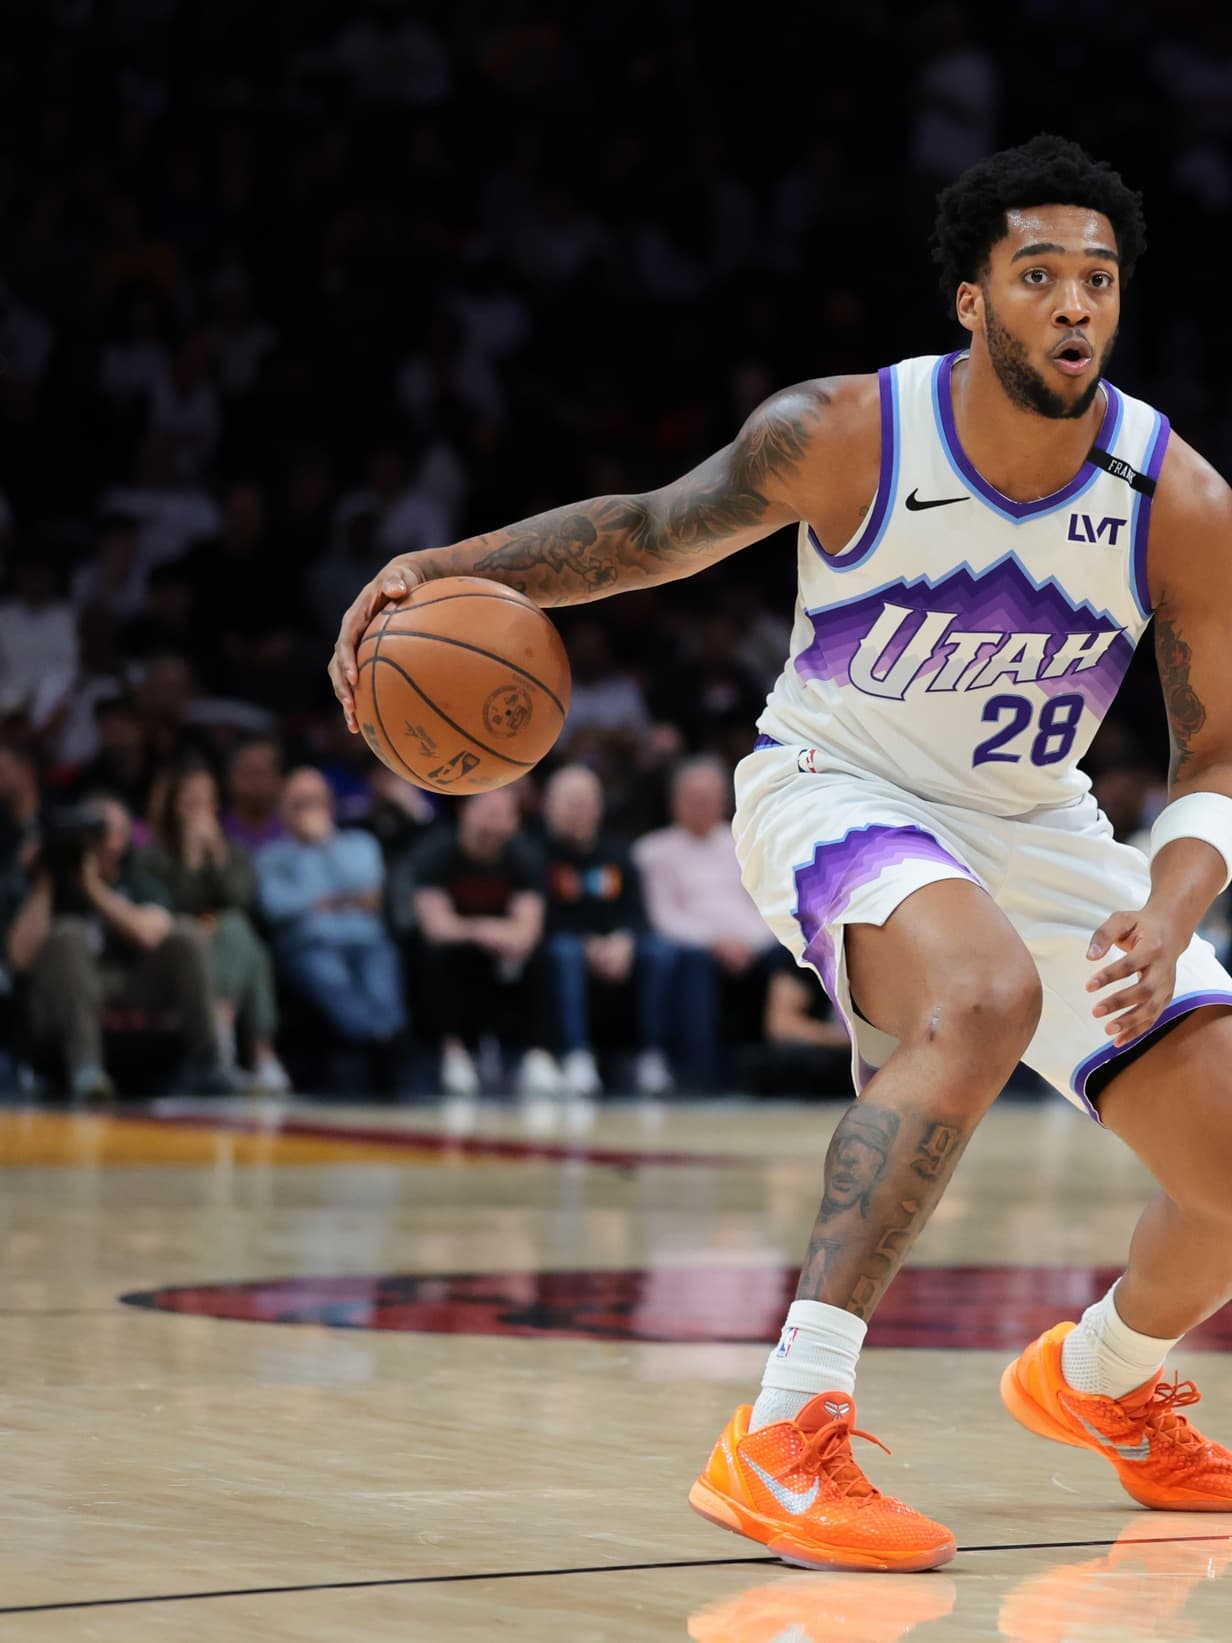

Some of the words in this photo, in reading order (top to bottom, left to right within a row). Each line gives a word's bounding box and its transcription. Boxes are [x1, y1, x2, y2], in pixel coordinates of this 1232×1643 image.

[1067, 513, 1128, 546] LVT
[848, 602, 1128, 701] UTAH
[971, 691, 1086, 768] 28
